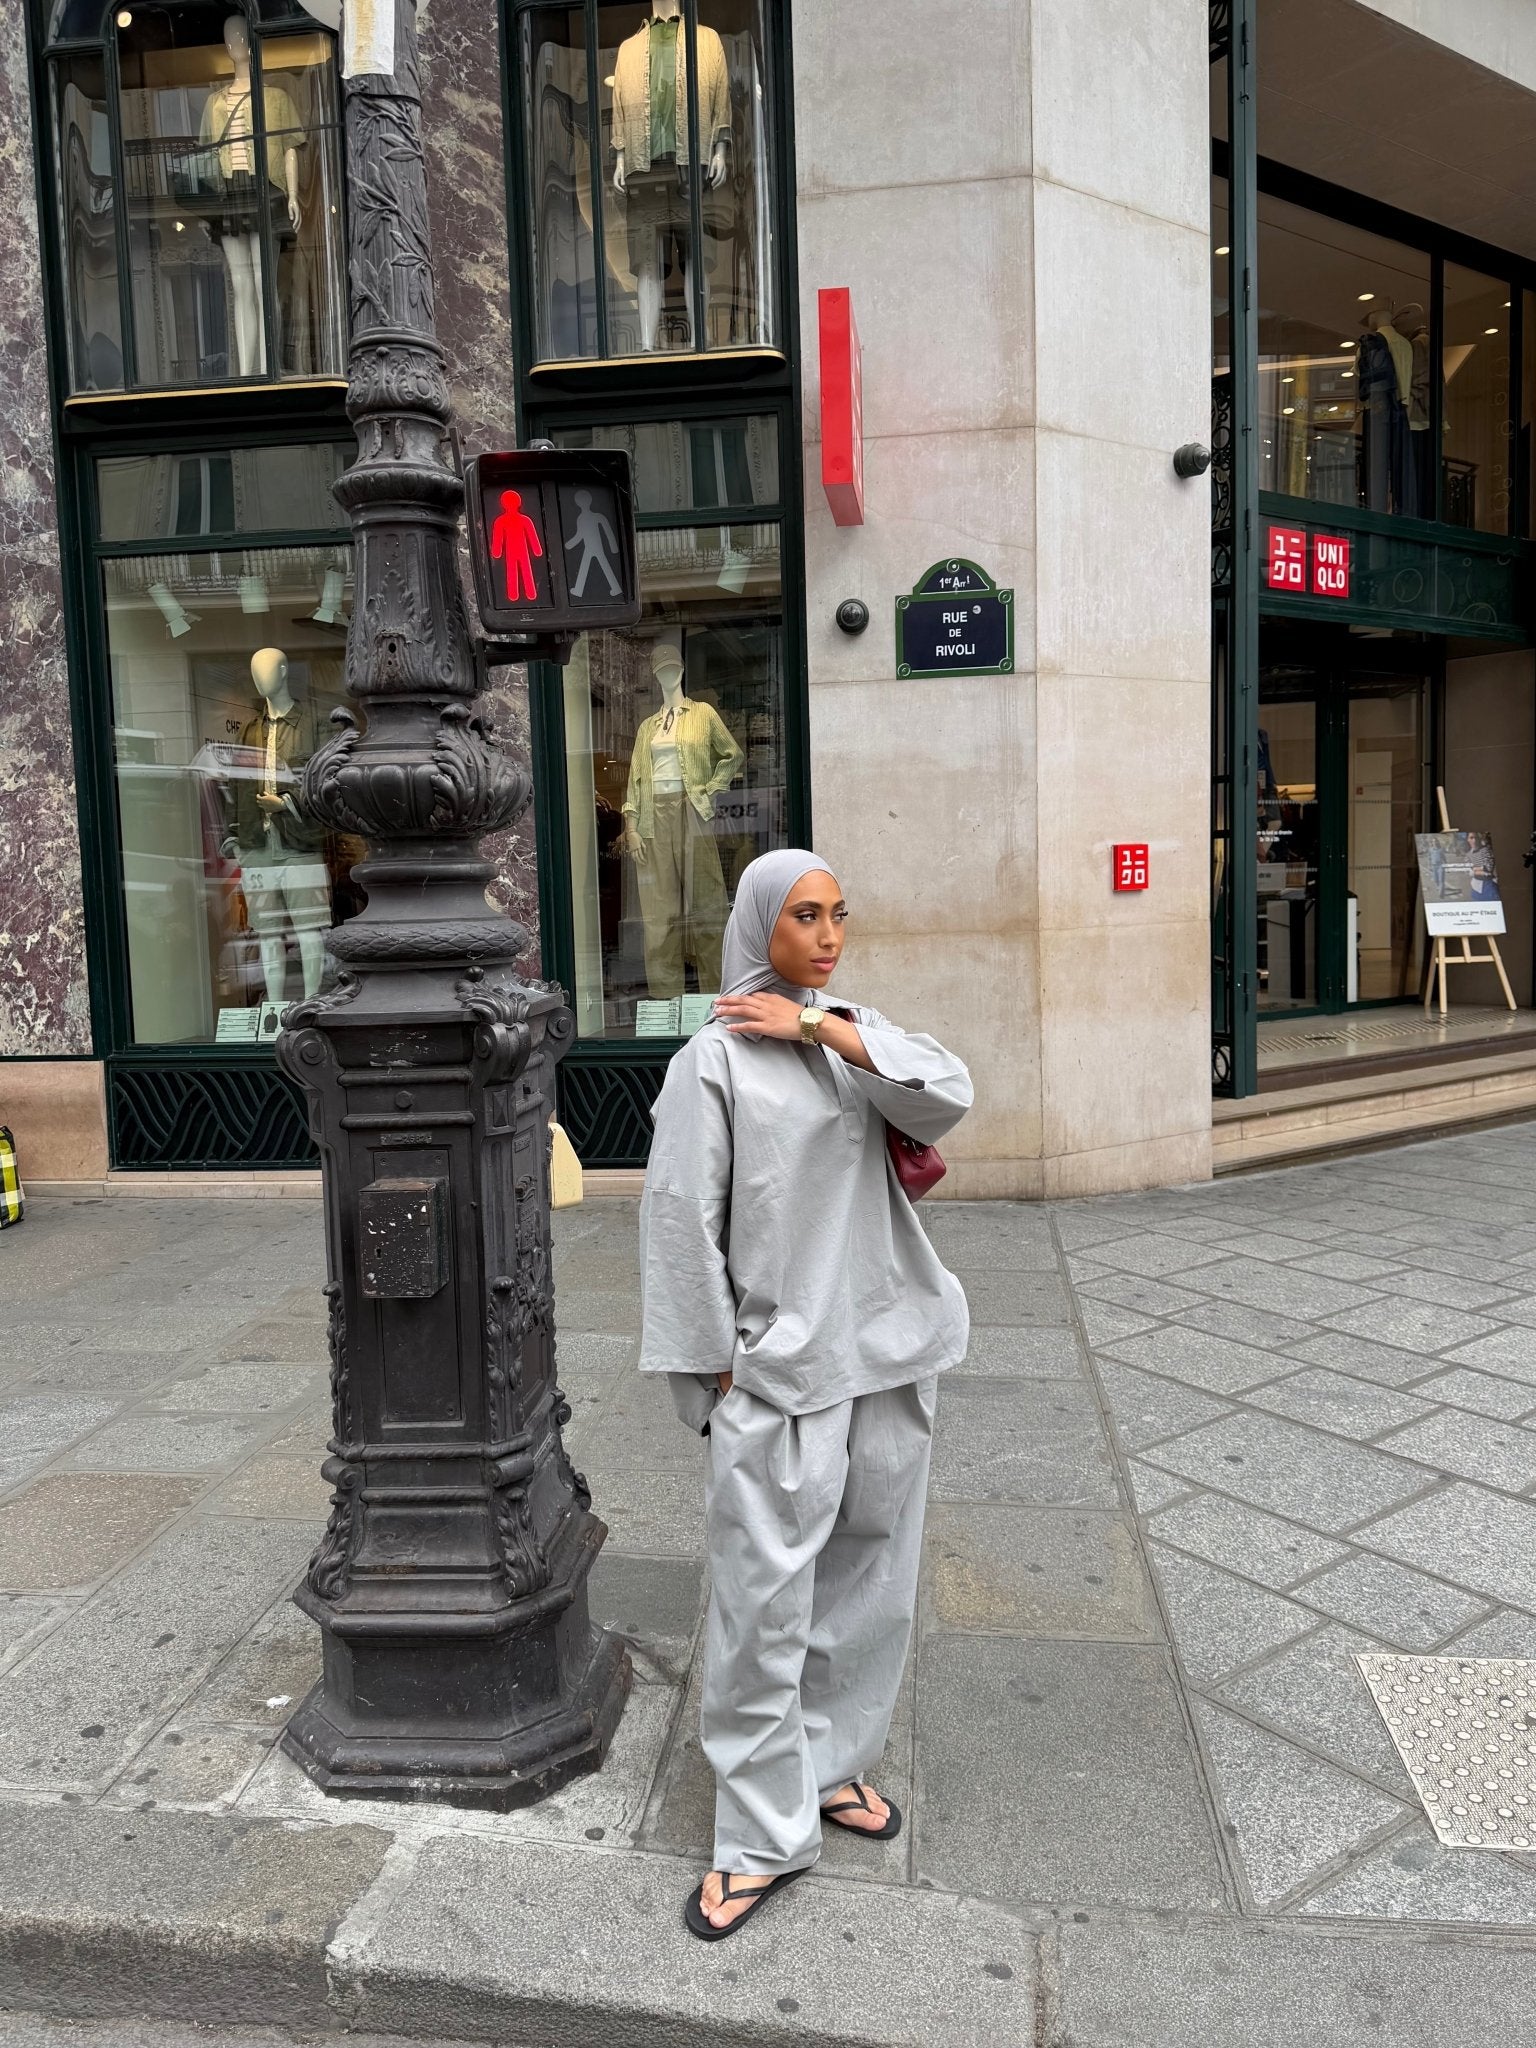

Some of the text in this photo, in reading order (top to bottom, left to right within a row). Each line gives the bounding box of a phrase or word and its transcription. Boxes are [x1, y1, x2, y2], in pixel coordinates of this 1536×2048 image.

[1274, 535, 1301, 558] ユニ
[1317, 542, 1343, 565] UNI
[1273, 560, 1301, 583] クロ
[1317, 567, 1345, 590] QLO
[939, 577, 952, 588] 1er
[942, 611, 968, 624] RUE
[949, 628, 962, 637] DE
[935, 643, 975, 657] RIVOLI
[1121, 849, 1145, 866] ユニ
[1121, 868, 1145, 885] クロ
